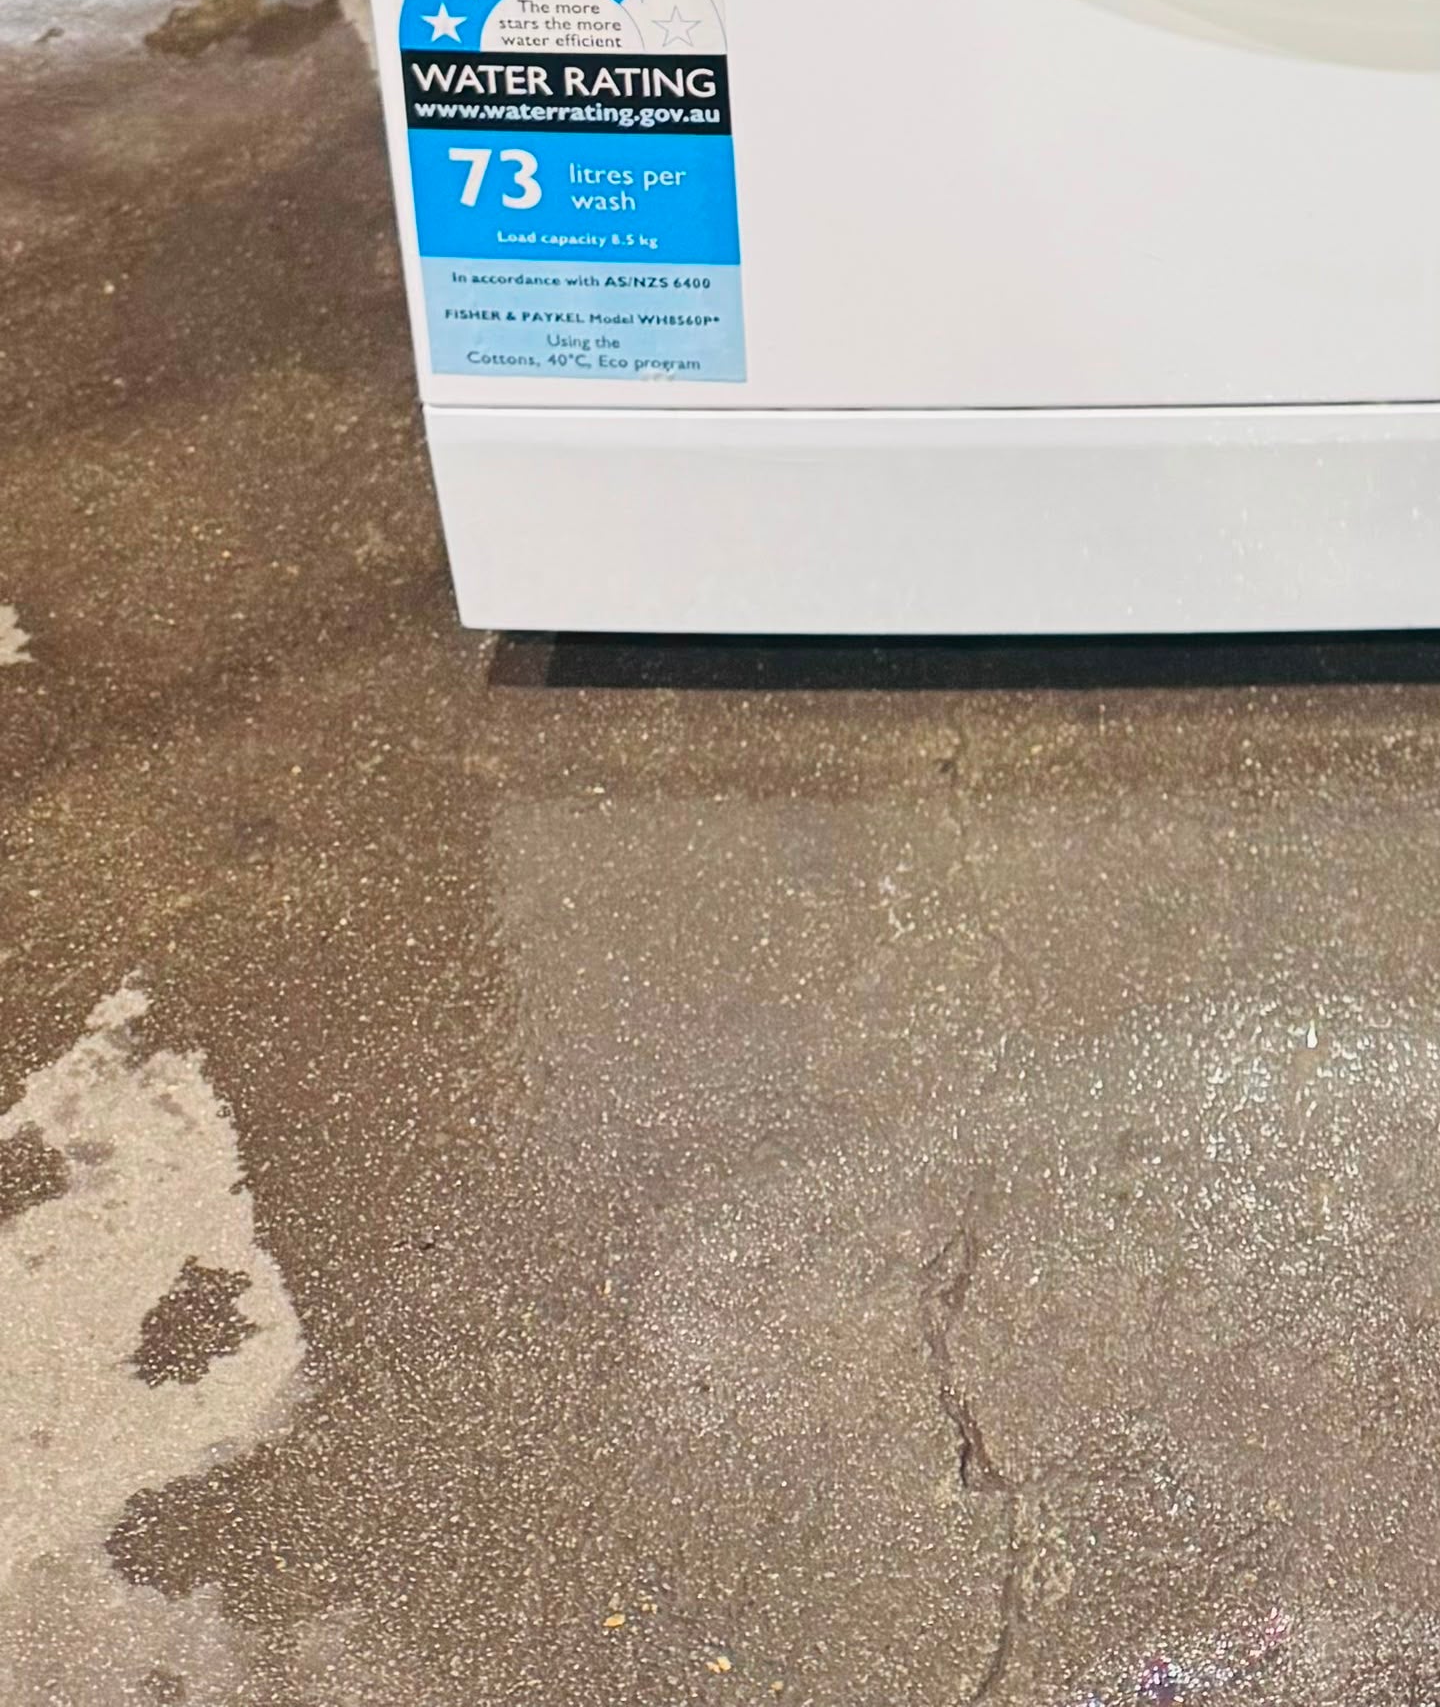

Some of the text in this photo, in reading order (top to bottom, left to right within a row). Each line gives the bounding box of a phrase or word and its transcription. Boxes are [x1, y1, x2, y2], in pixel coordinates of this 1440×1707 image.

[517, 0, 601, 15] The more
[499, 17, 622, 32] stars the more
[501, 33, 623, 49] water efficient
[412, 63, 717, 99] WATER RATING
[414, 100, 721, 128] www.waterrating.gov.au
[448, 147, 543, 210] 73
[569, 163, 687, 191] litres per
[571, 192, 637, 212] wash
[497, 231, 658, 249] Load capacity 8.5 kg
[452, 272, 711, 289] In accordance with AS/NZS 6400
[445, 309, 500, 321] FISHER
[507, 311, 516, 321] &
[523, 311, 585, 323] PAYKEL
[589, 313, 634, 324] Model
[547, 335, 620, 350] Using the
[467, 352, 540, 367] Cottons,
[599, 356, 628, 368] Eco
[635, 357, 701, 371] program
